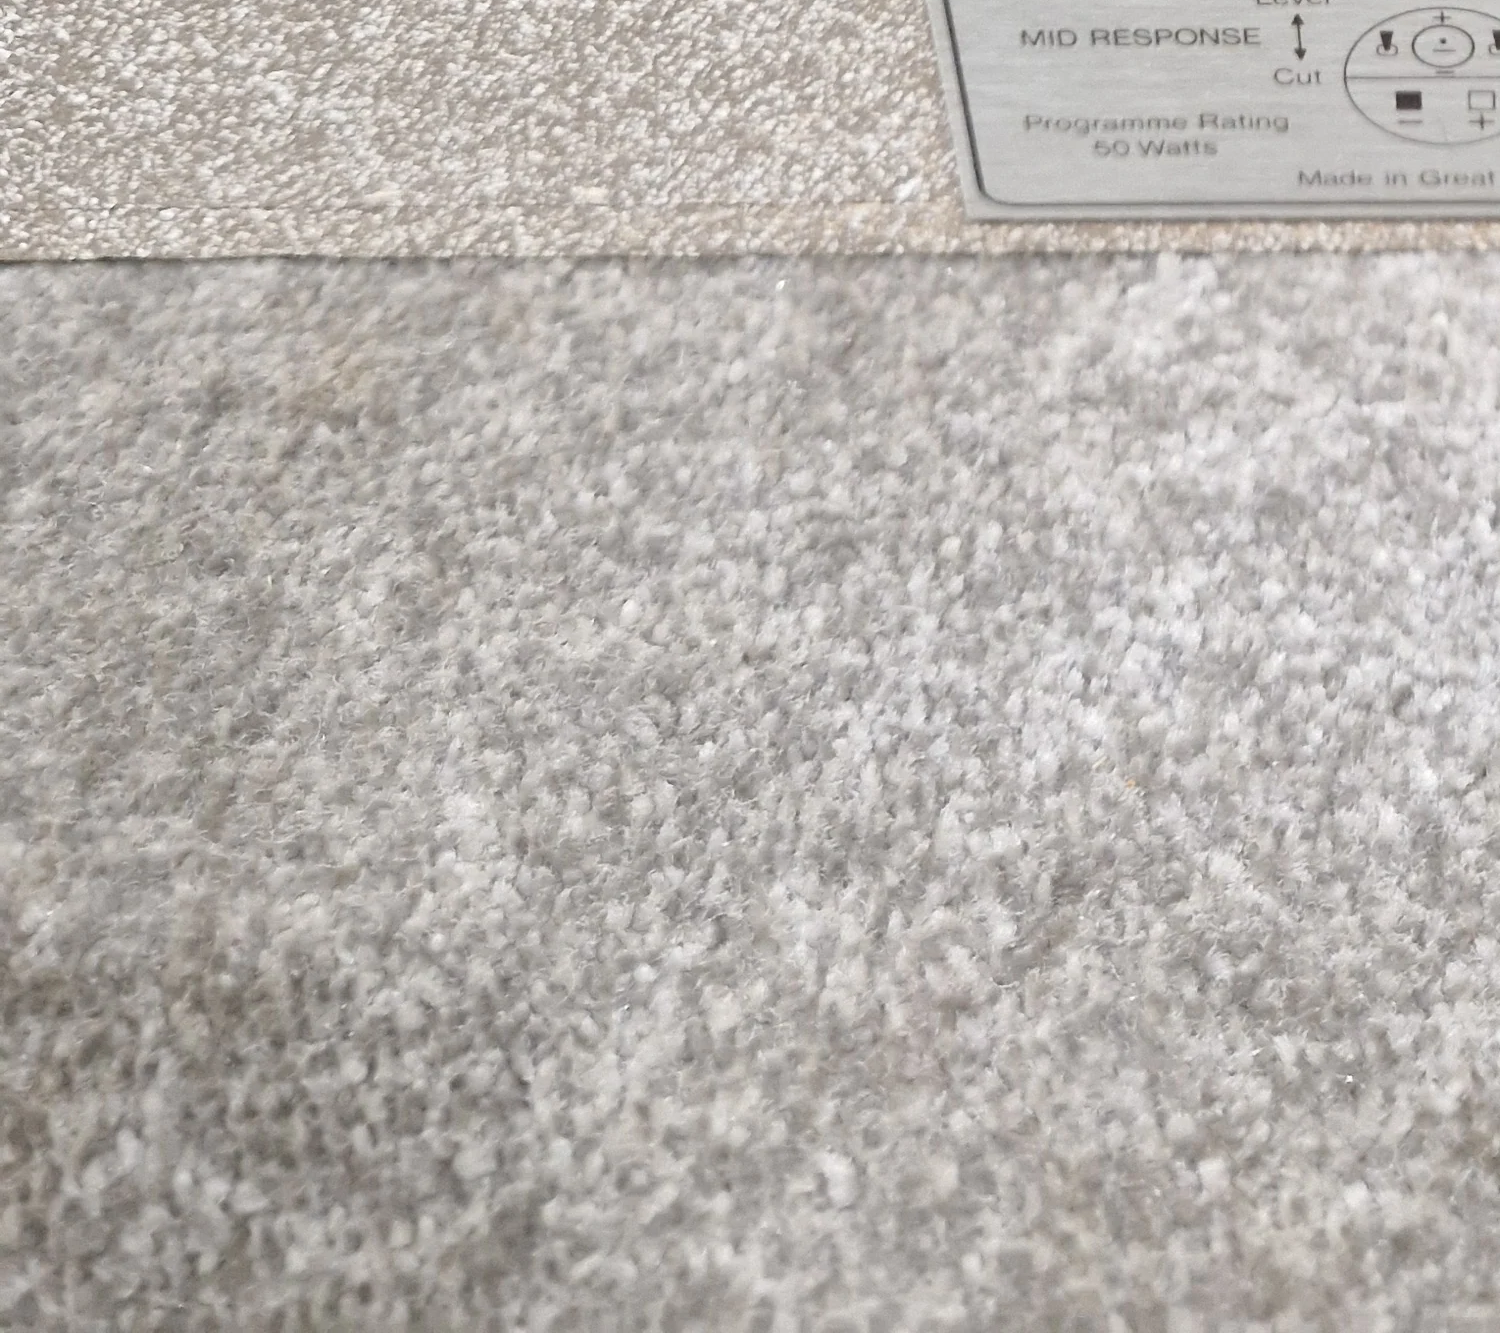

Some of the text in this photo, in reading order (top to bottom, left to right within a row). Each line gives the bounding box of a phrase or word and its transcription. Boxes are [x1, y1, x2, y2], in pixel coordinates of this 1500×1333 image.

[1020, 27, 1263, 48] MID RESPONSE
[1273, 68, 1323, 86] Cut
[1023, 113, 1291, 135] Programme Rating
[1093, 138, 1219, 158] 50 Watts
[1296, 169, 1373, 188] Made
[1384, 169, 1409, 187] in
[1419, 169, 1496, 187] Great
